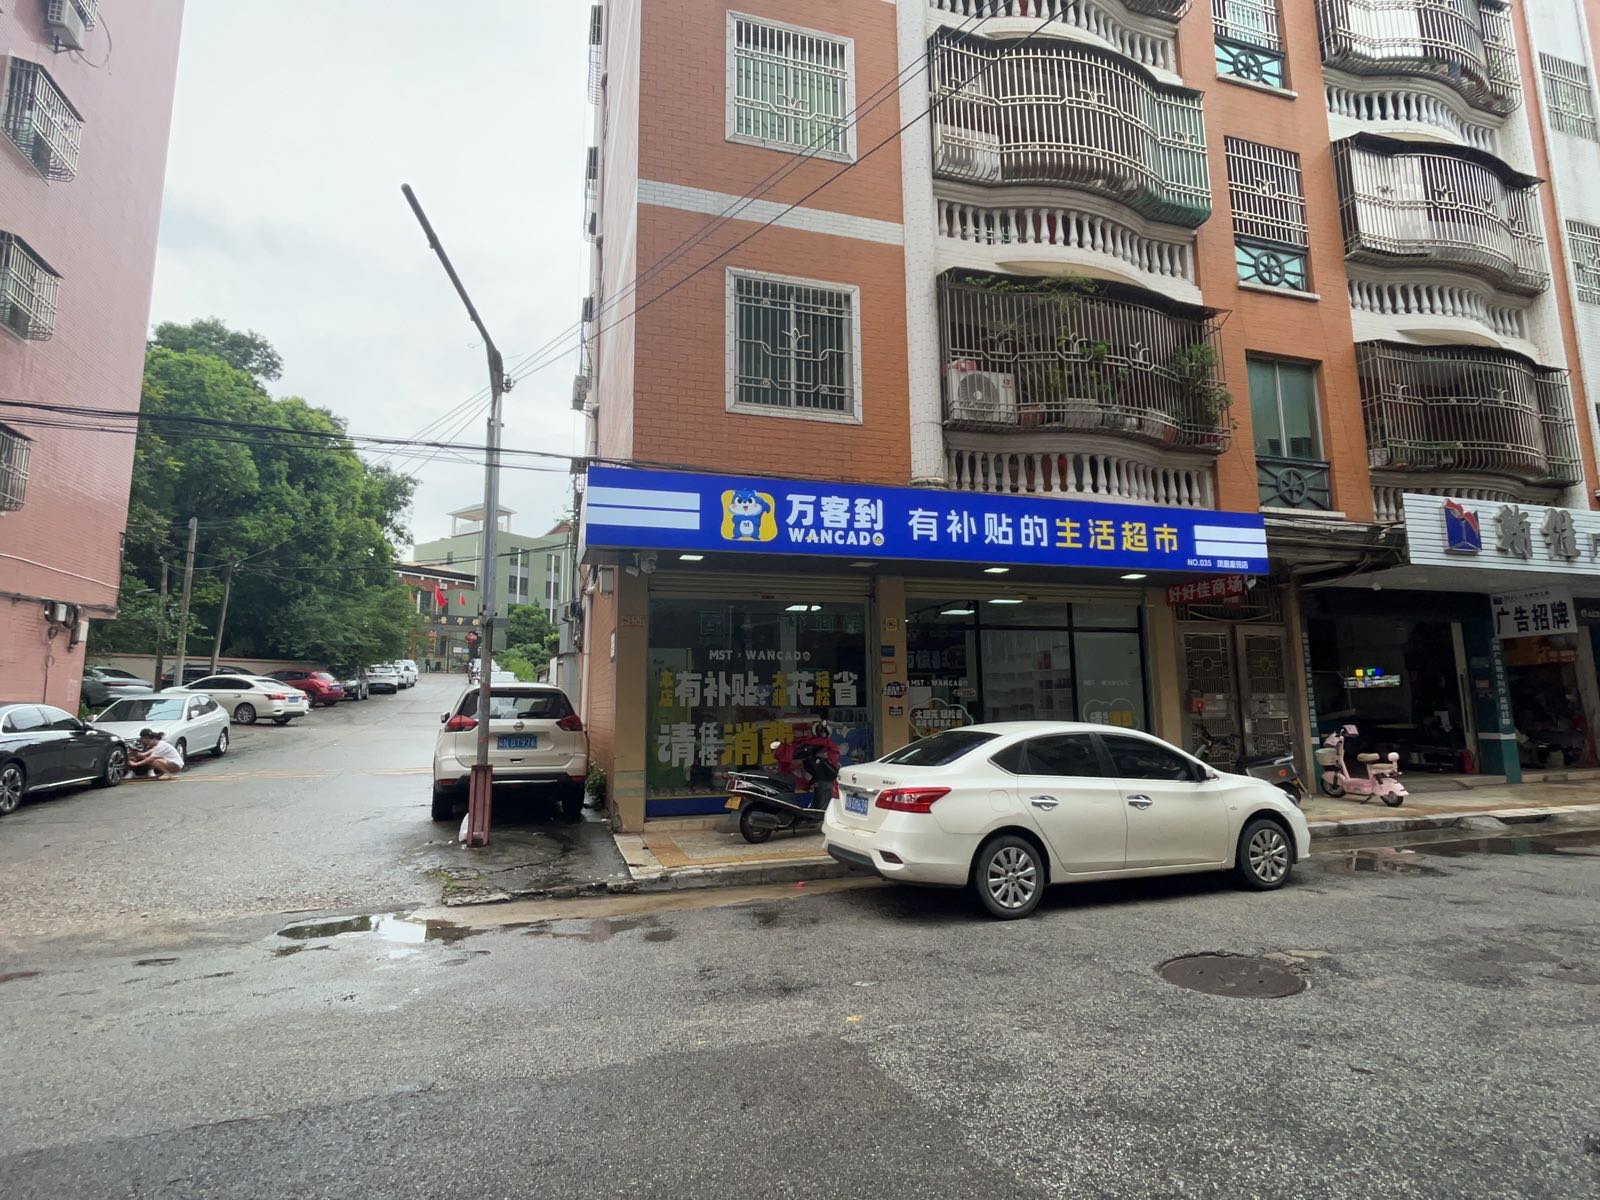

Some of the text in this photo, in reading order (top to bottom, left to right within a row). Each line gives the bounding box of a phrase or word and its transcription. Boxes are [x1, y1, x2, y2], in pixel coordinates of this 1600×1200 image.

[785, 494, 883, 530] 万客到
[788, 527, 885, 547] WANCADO
[907, 507, 1179, 553] 有补贴的生活超市
[1187, 558, 1212, 567] NO.035
[1168, 575, 1244, 605] 好好佳商场
[1496, 600, 1570, 635] 广告招牌
[709, 649, 733, 661] MST
[745, 650, 812, 662] WANCADO
